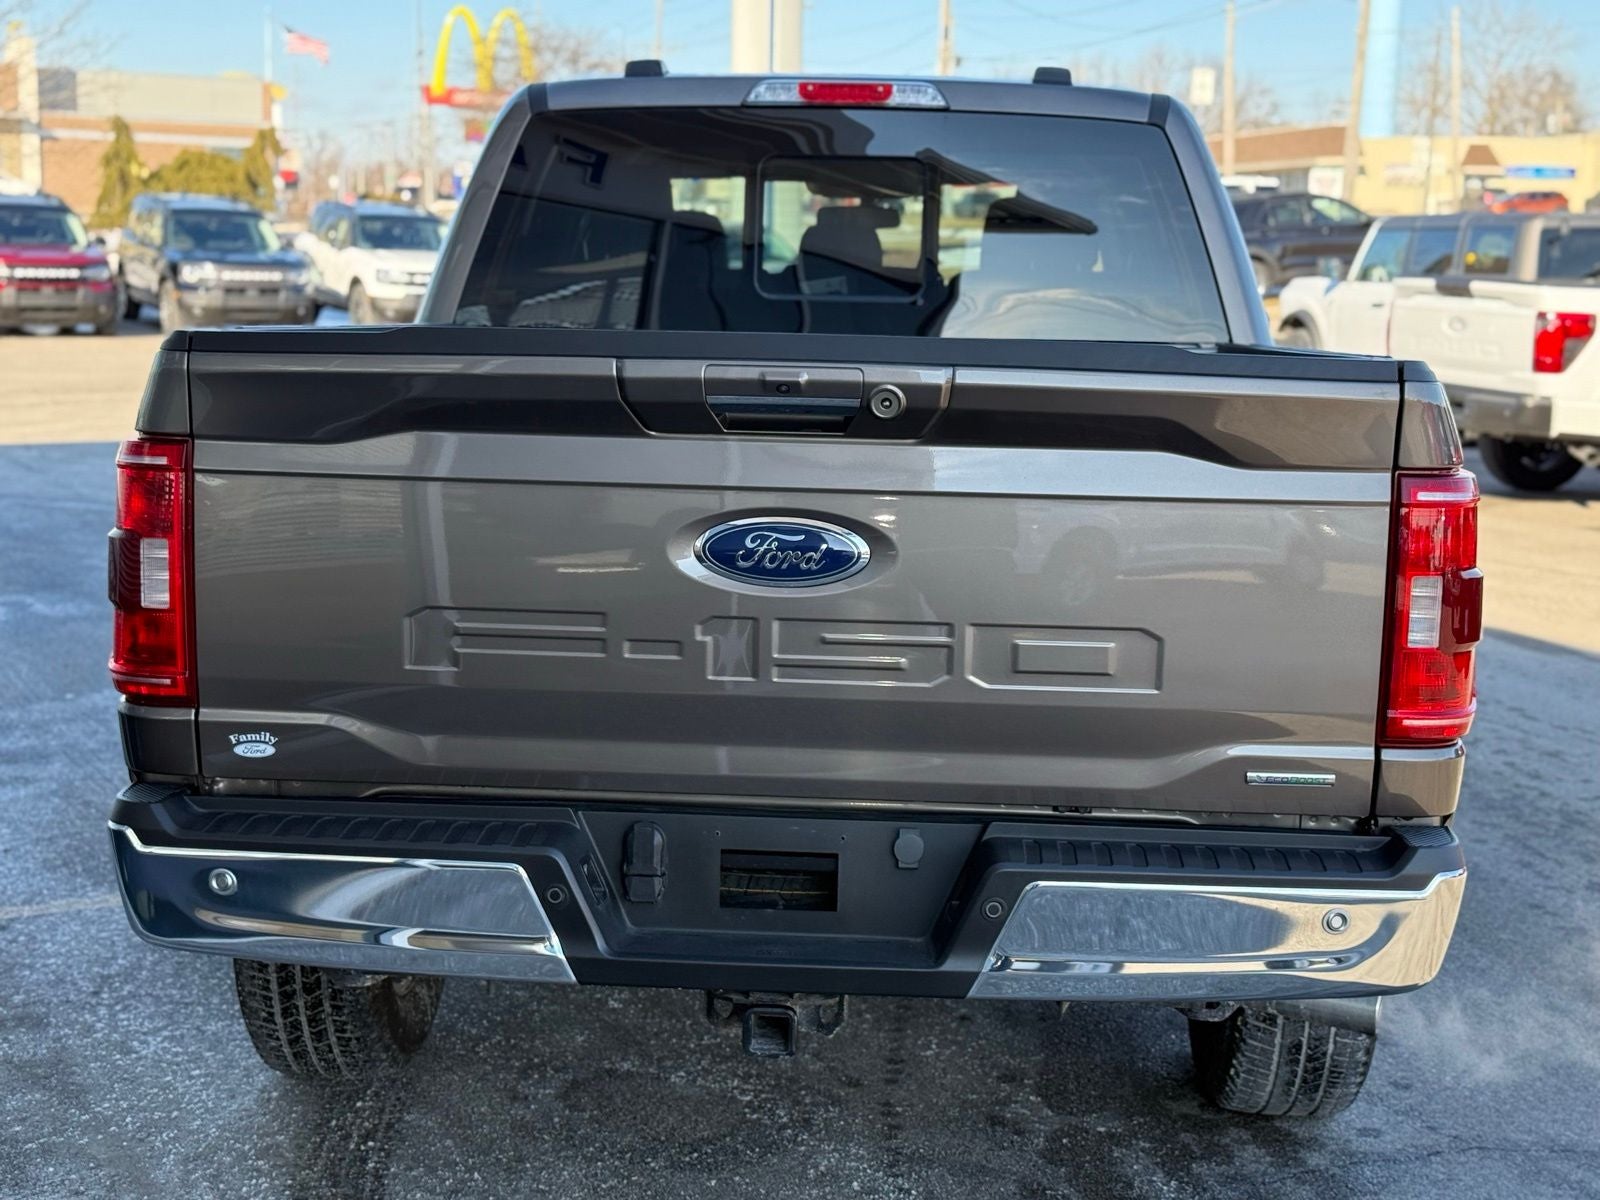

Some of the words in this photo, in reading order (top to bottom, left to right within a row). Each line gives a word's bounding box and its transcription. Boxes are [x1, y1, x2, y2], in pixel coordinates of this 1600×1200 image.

[735, 531, 829, 570] Ford
[404, 605, 1164, 694] F-150
[229, 731, 278, 744] Family
[242, 744, 267, 754] Ford
